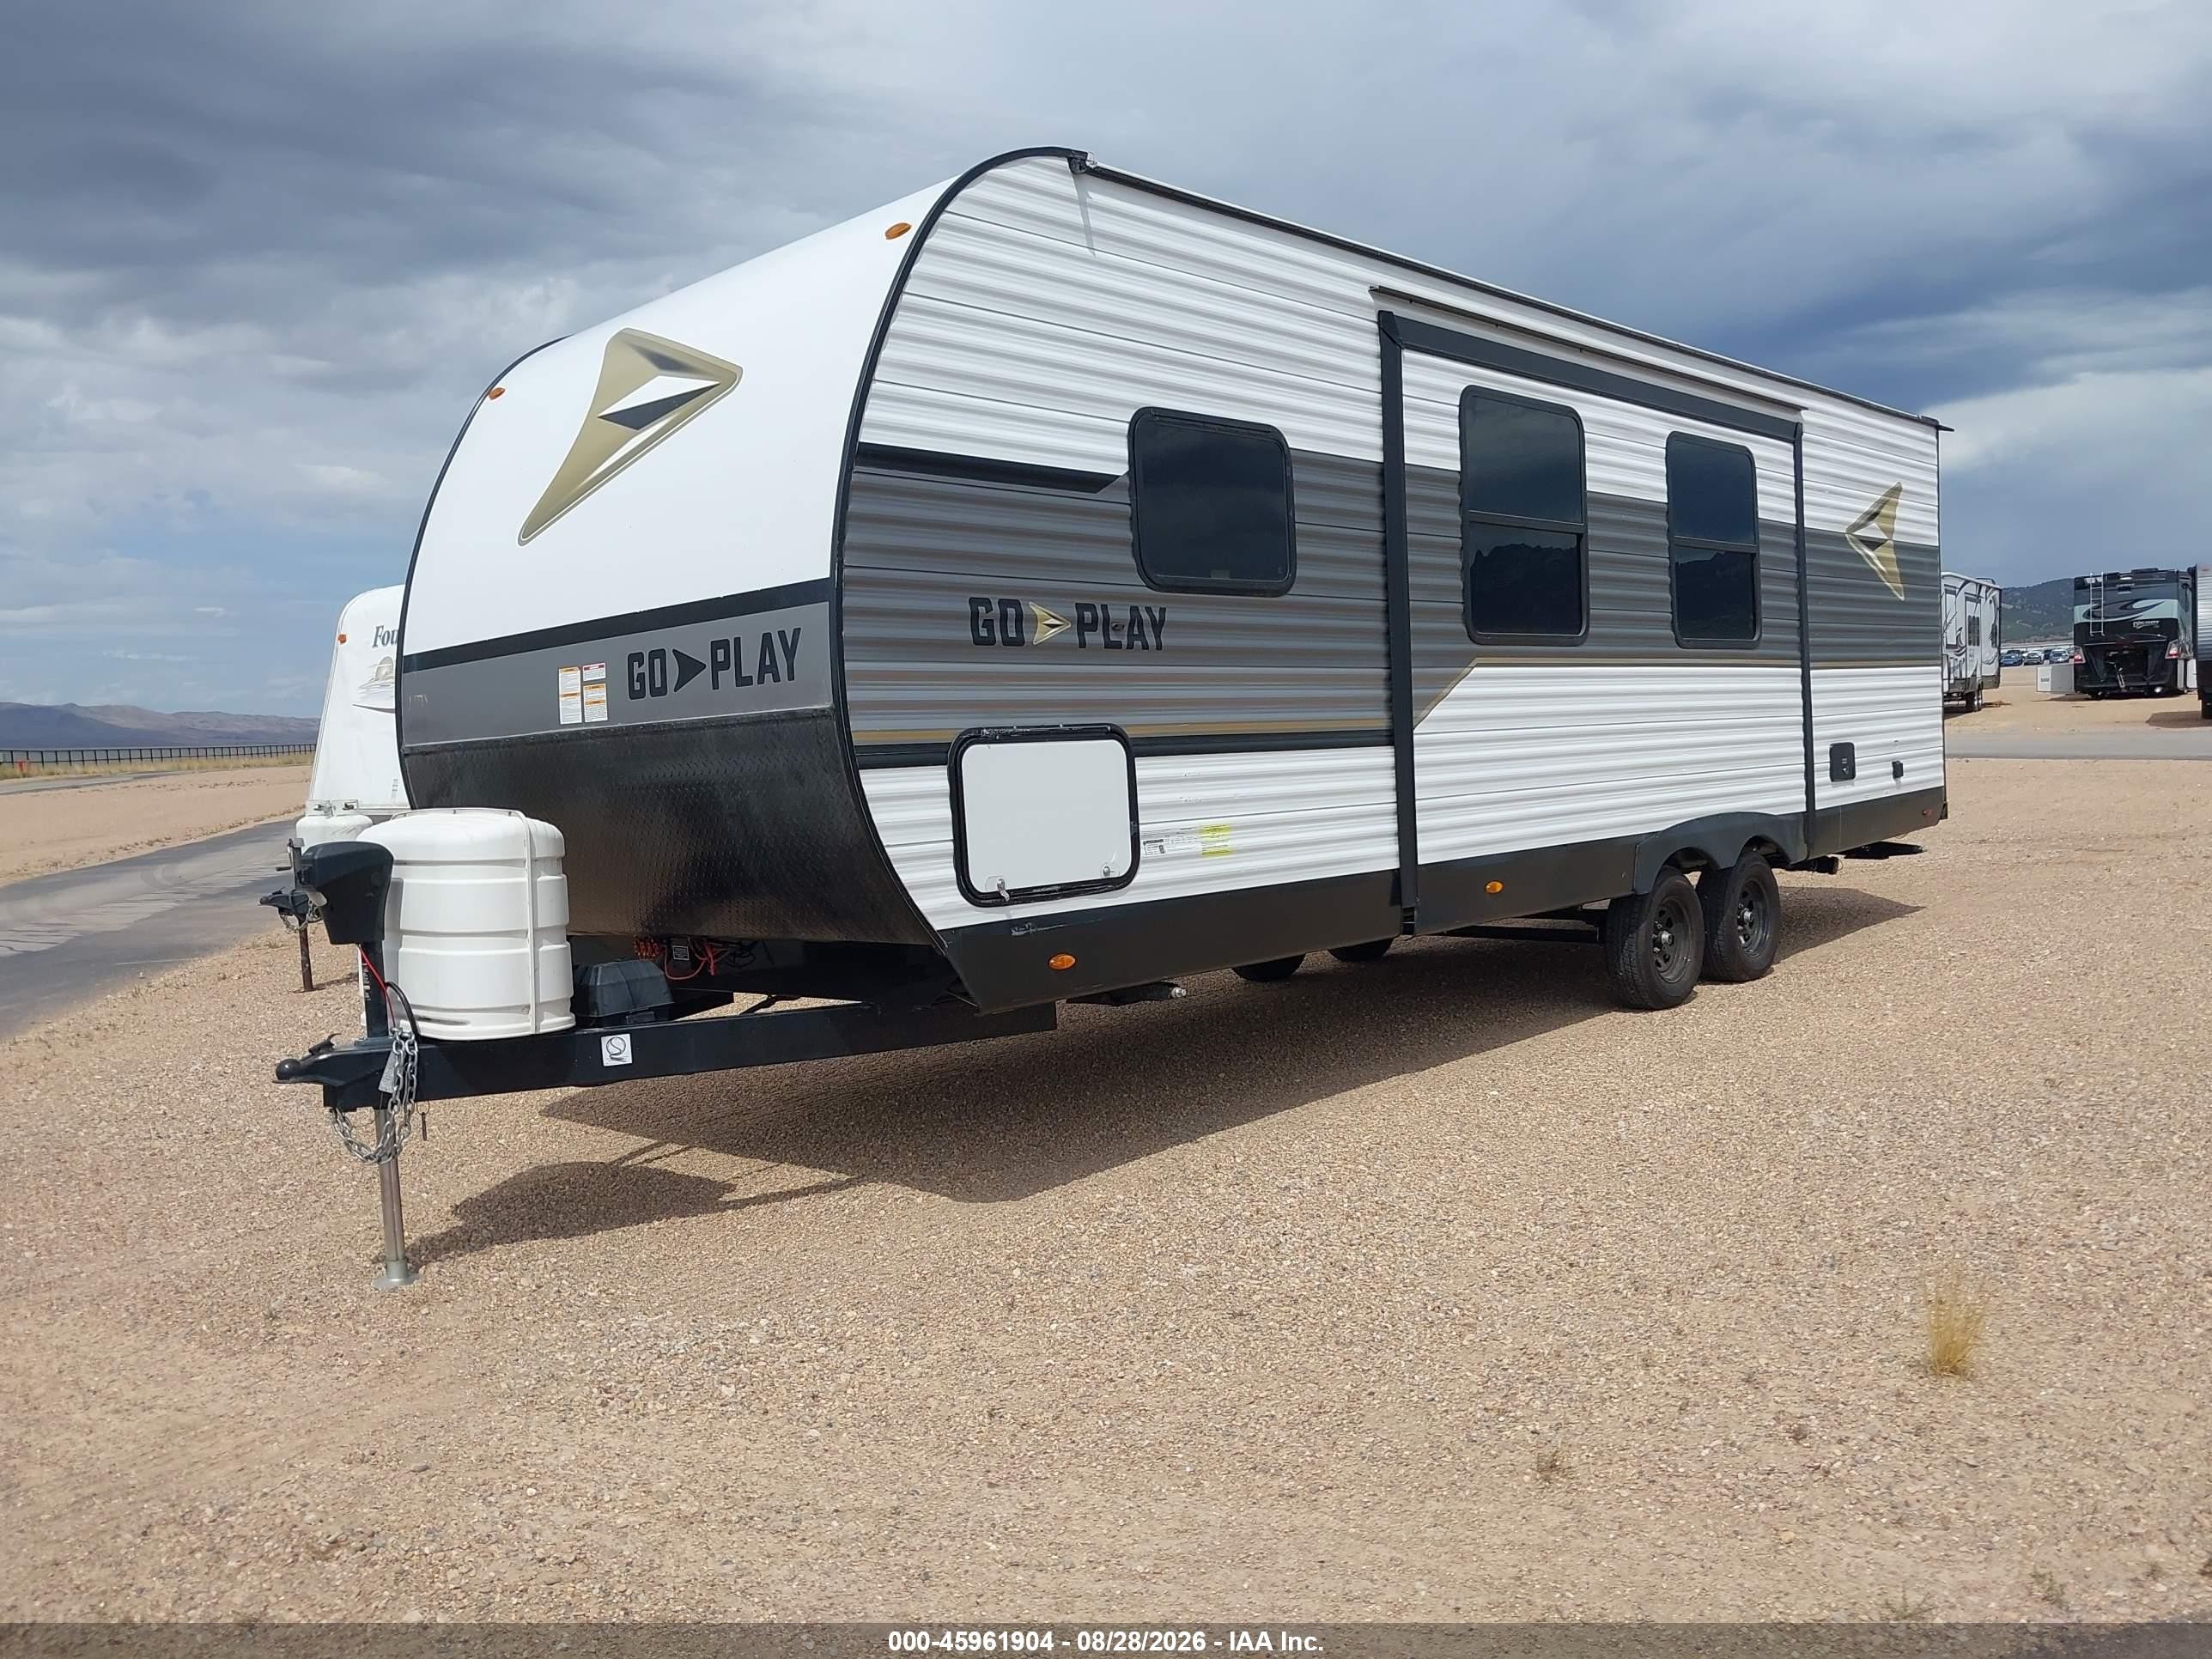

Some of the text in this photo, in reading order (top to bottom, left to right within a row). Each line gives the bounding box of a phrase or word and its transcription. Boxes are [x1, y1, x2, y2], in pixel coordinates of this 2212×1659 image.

[969, 597, 1166, 650] GO PLAY
[628, 647, 667, 700] GO
[710, 628, 801, 690] PLAY
